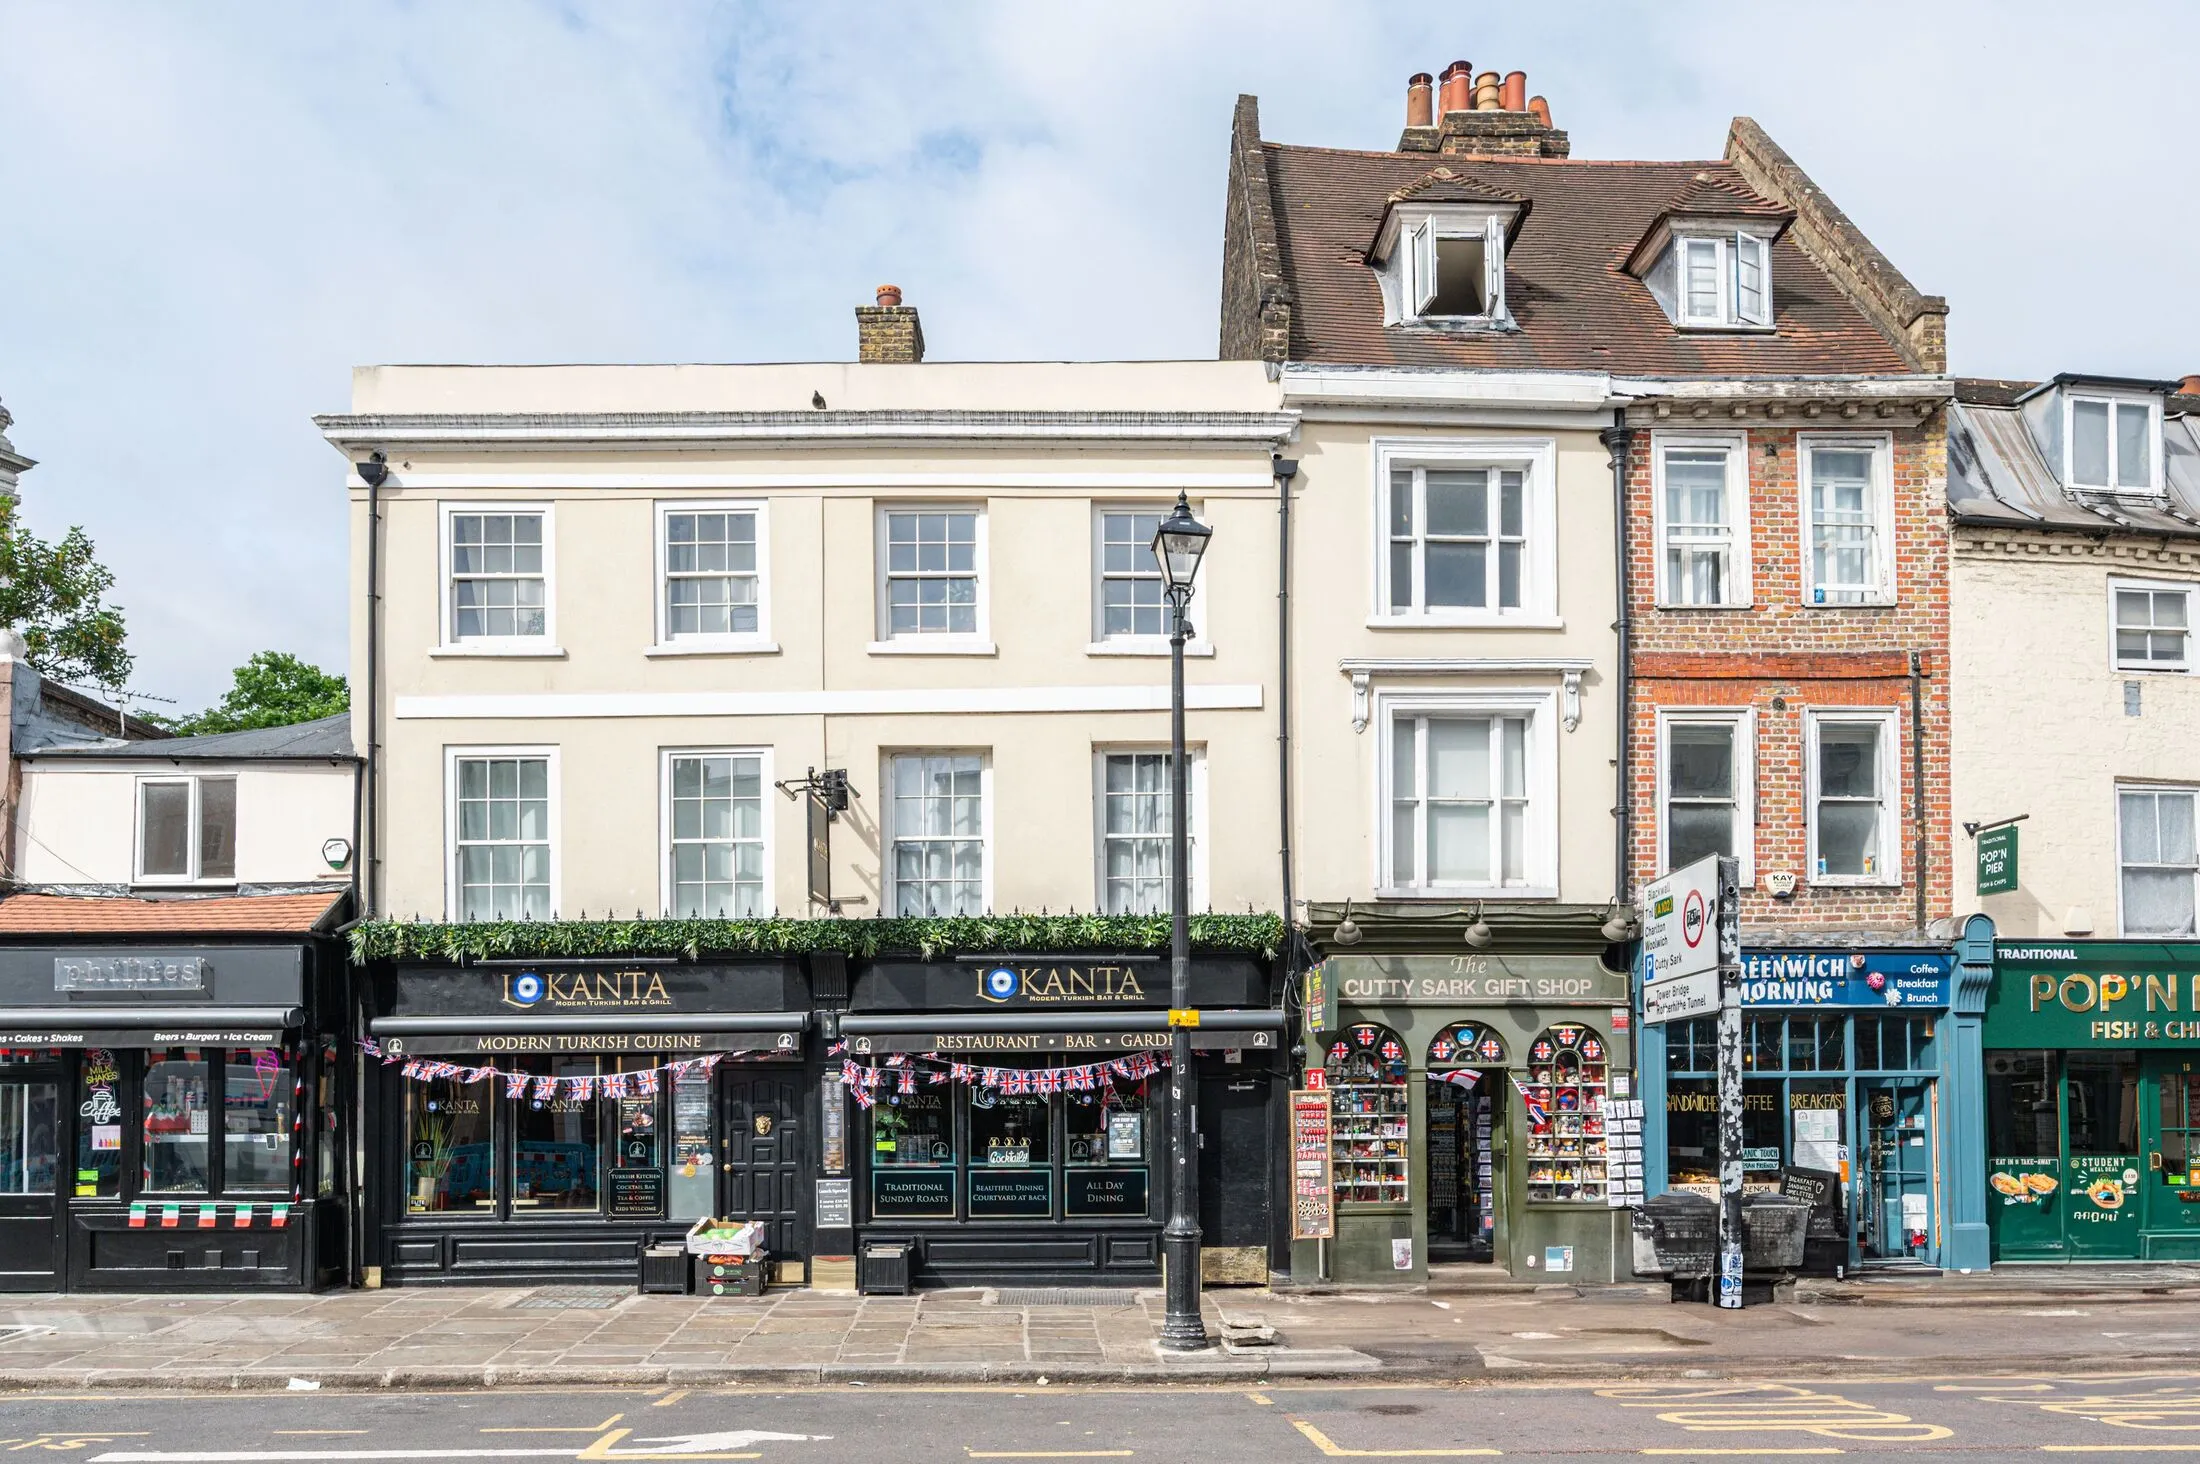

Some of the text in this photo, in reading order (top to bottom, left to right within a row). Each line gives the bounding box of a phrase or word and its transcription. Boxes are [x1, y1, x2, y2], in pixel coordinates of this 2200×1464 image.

[1980, 848, 2008, 864] POP'N
[1985, 861, 2003, 875] PIER
[1645, 922, 1666, 938] Charlton
[1645, 936, 1668, 952] Woolwich
[1655, 959, 1669, 972] Cutty
[1670, 952, 1682, 966] Sark
[1997, 949, 2077, 960] TRADITIONAL
[1450, 955, 1487, 974] The
[1740, 958, 1844, 979] REENWICH
[1910, 965, 1939, 974] Coffee
[63, 960, 195, 987] phillies
[1344, 978, 1592, 996] CUTTY SARK GIFT SHOP
[1656, 983, 1690, 1001] Tower Bridge
[1897, 980, 1939, 989] Breakfast
[1656, 993, 1707, 1016] Rotherhithe Tunnel
[1907, 994, 1938, 1003] Brunch
[14, 1034, 43, 1043] Cakes
[50, 1033, 84, 1042] Shakes
[154, 1033, 273, 1042] Beers Burgers Ice Cream
[2091, 1021, 2139, 1040] FISH
[2144, 1021, 2160, 1040] &
[477, 1035, 701, 1050] MODERN TURKISH CUISINE
[936, 1034, 1173, 1049] RESTAURANT BAR GARD
[86, 1071, 118, 1083] SHAKES
[90, 1065, 112, 1075] MILK
[1310, 1072, 1324, 1089] £1
[1791, 1093, 1846, 1109] BREAKFAST
[2082, 1157, 2125, 1167] STUDENT
[885, 1183, 944, 1191] TRADITIONAL
[1105, 1182, 1124, 1190] DAY
[880, 1195, 914, 1203] SUNDAY
[1087, 1194, 1124, 1202] DINING
